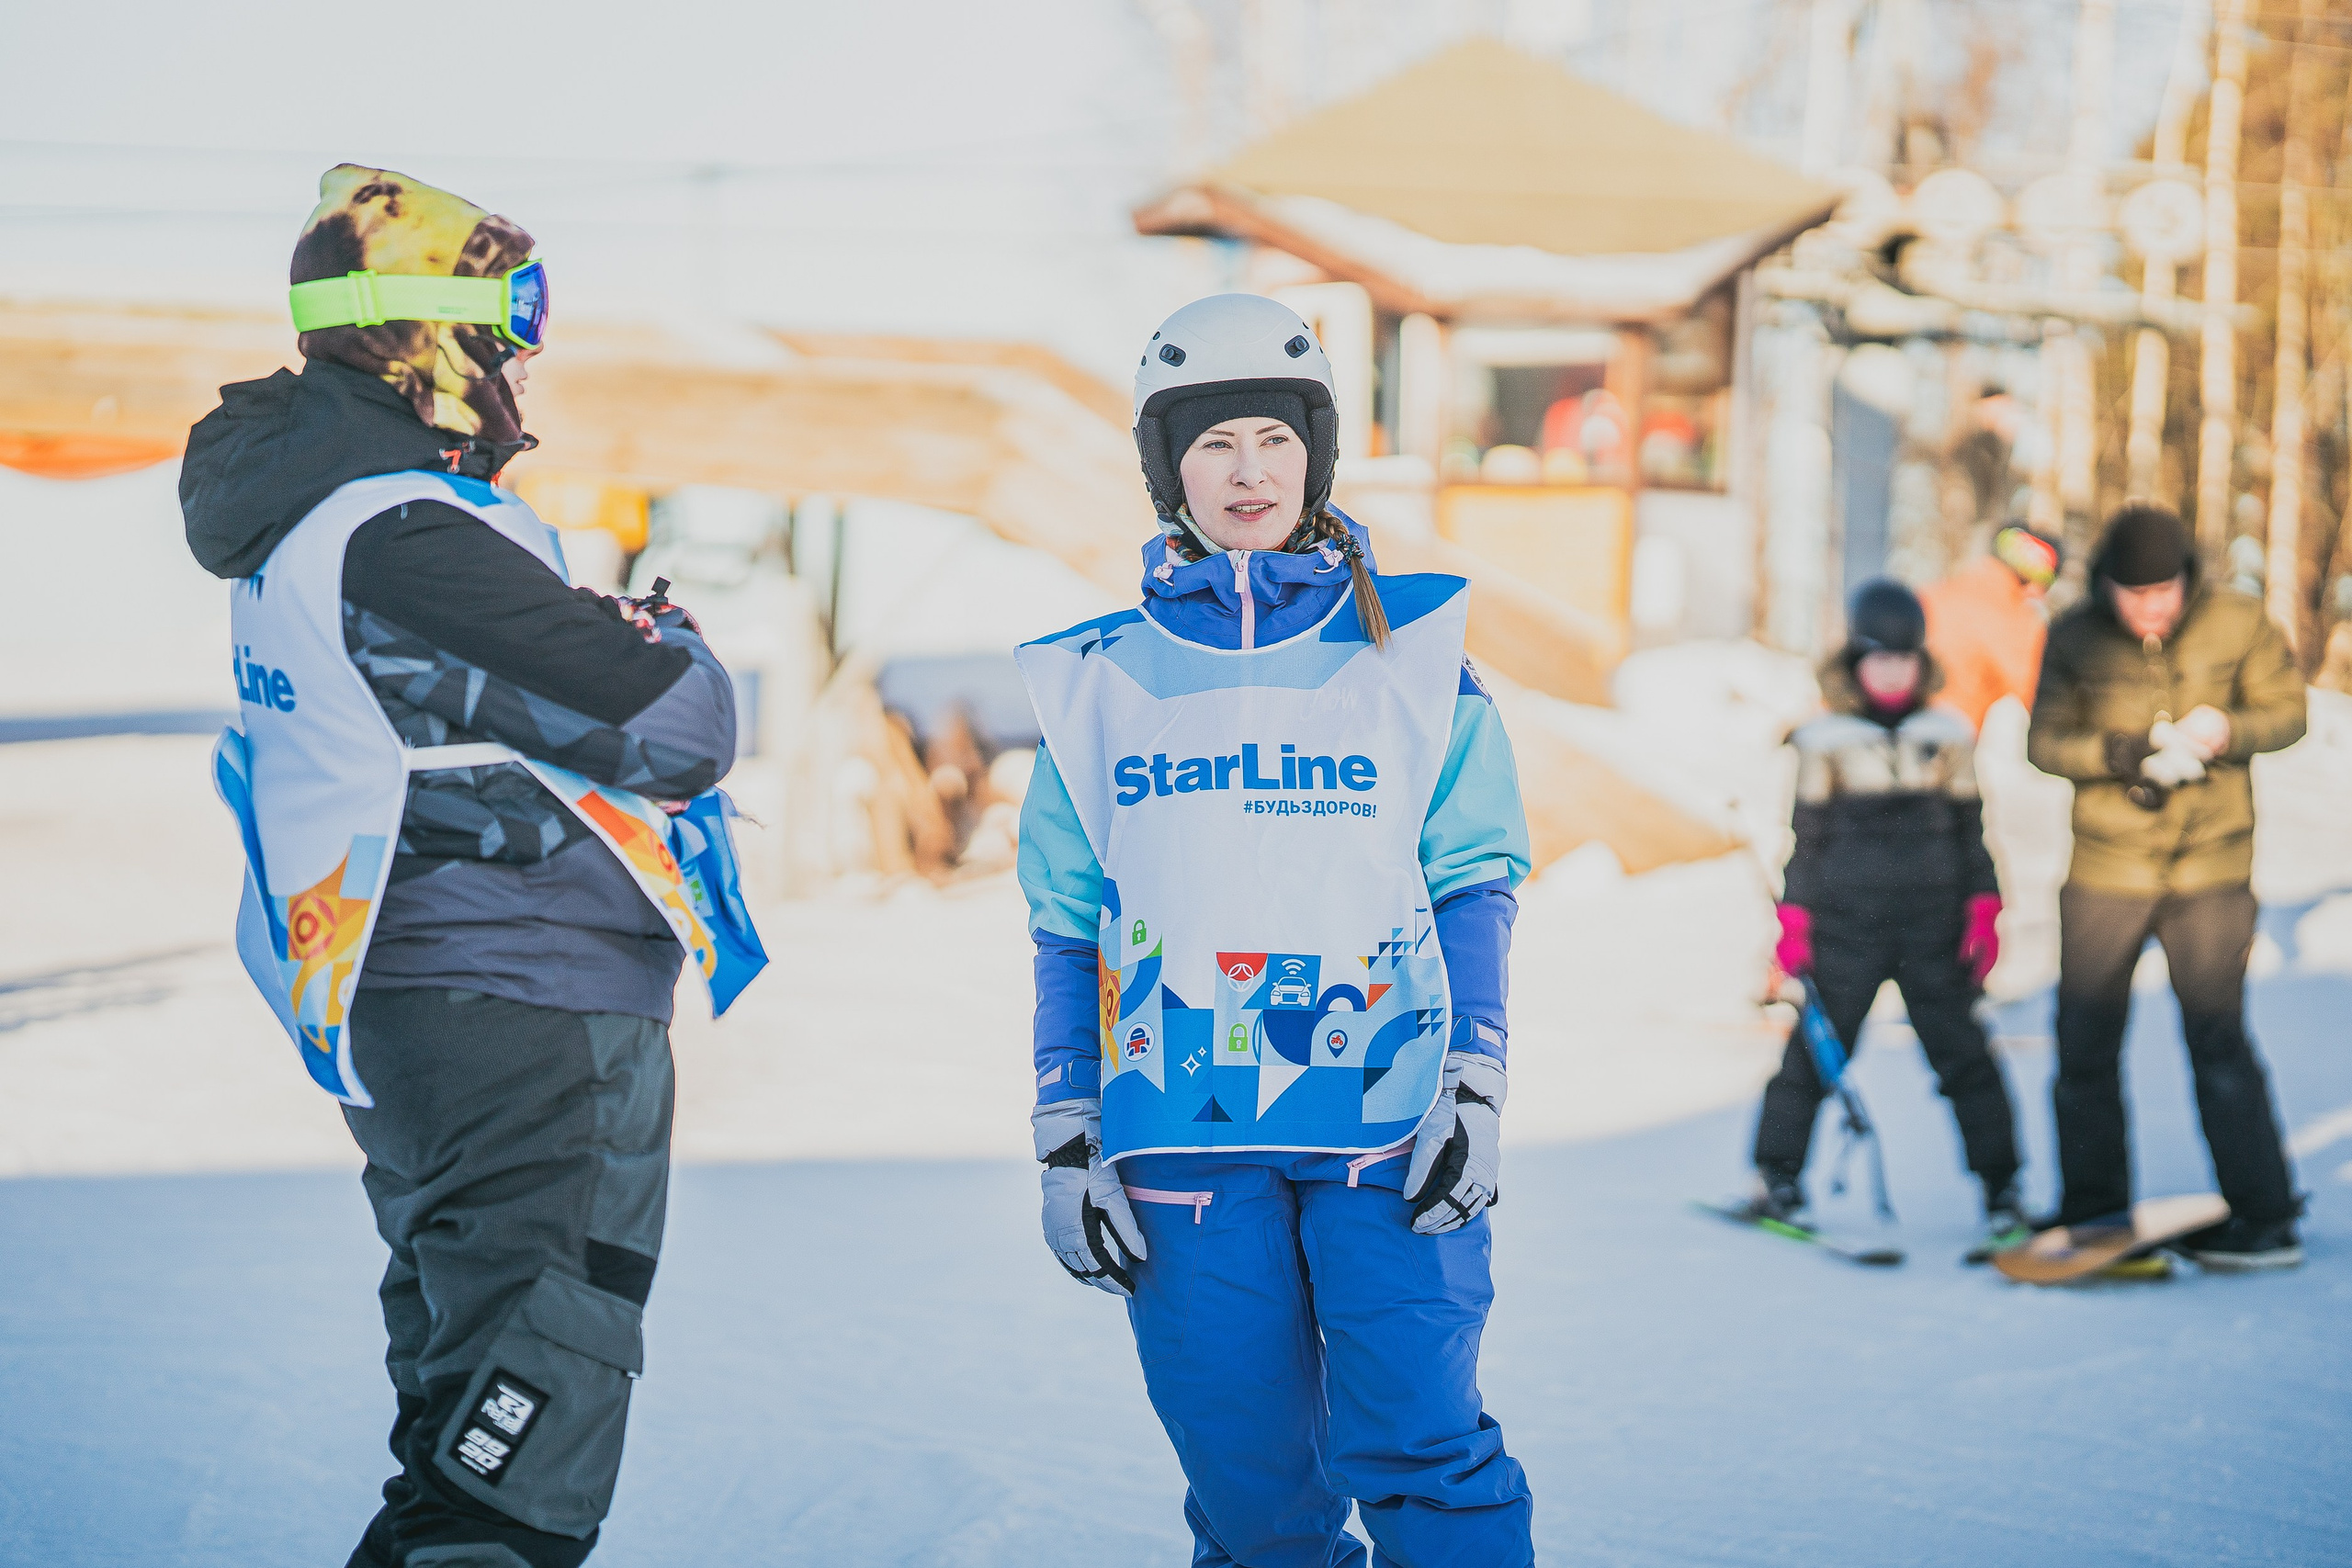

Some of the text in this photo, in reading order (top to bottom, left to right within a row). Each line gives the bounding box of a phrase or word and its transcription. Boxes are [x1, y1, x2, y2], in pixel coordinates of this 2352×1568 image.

[234, 645, 295, 712] Line
[1114, 743, 1378, 806] StarLine
[1243, 800, 1377, 818] #БУДЬЗДОРОВ!
